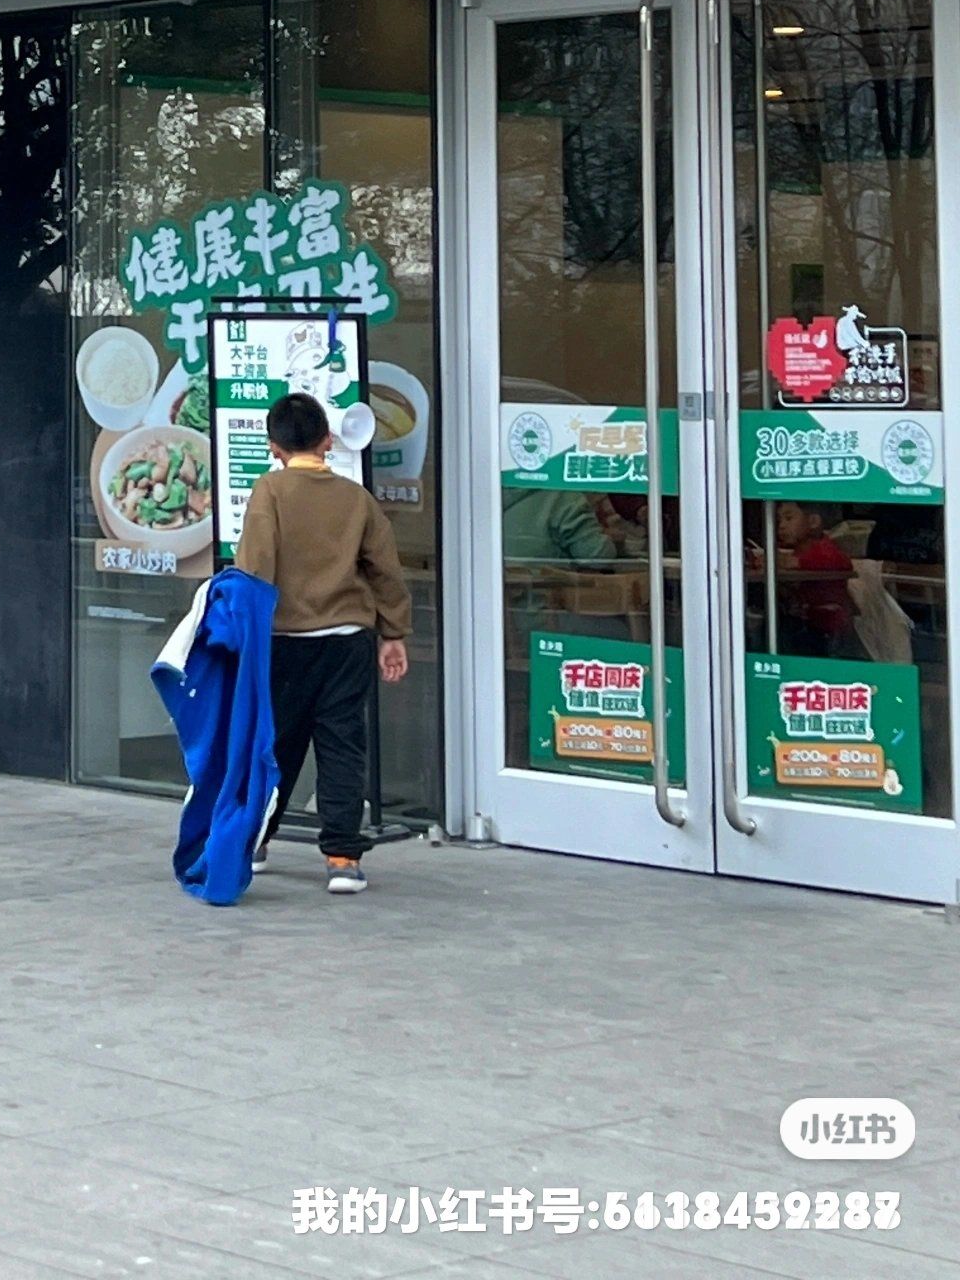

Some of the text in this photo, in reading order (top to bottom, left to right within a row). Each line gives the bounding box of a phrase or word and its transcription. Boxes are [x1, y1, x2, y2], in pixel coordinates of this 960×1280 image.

[126, 185, 341, 302] 健康丰富
[230, 344, 268, 360] 大平台
[230, 382, 269, 400] 升职快
[757, 428, 859, 457] 30多款选择
[102, 546, 177, 574] 农家小炒肉
